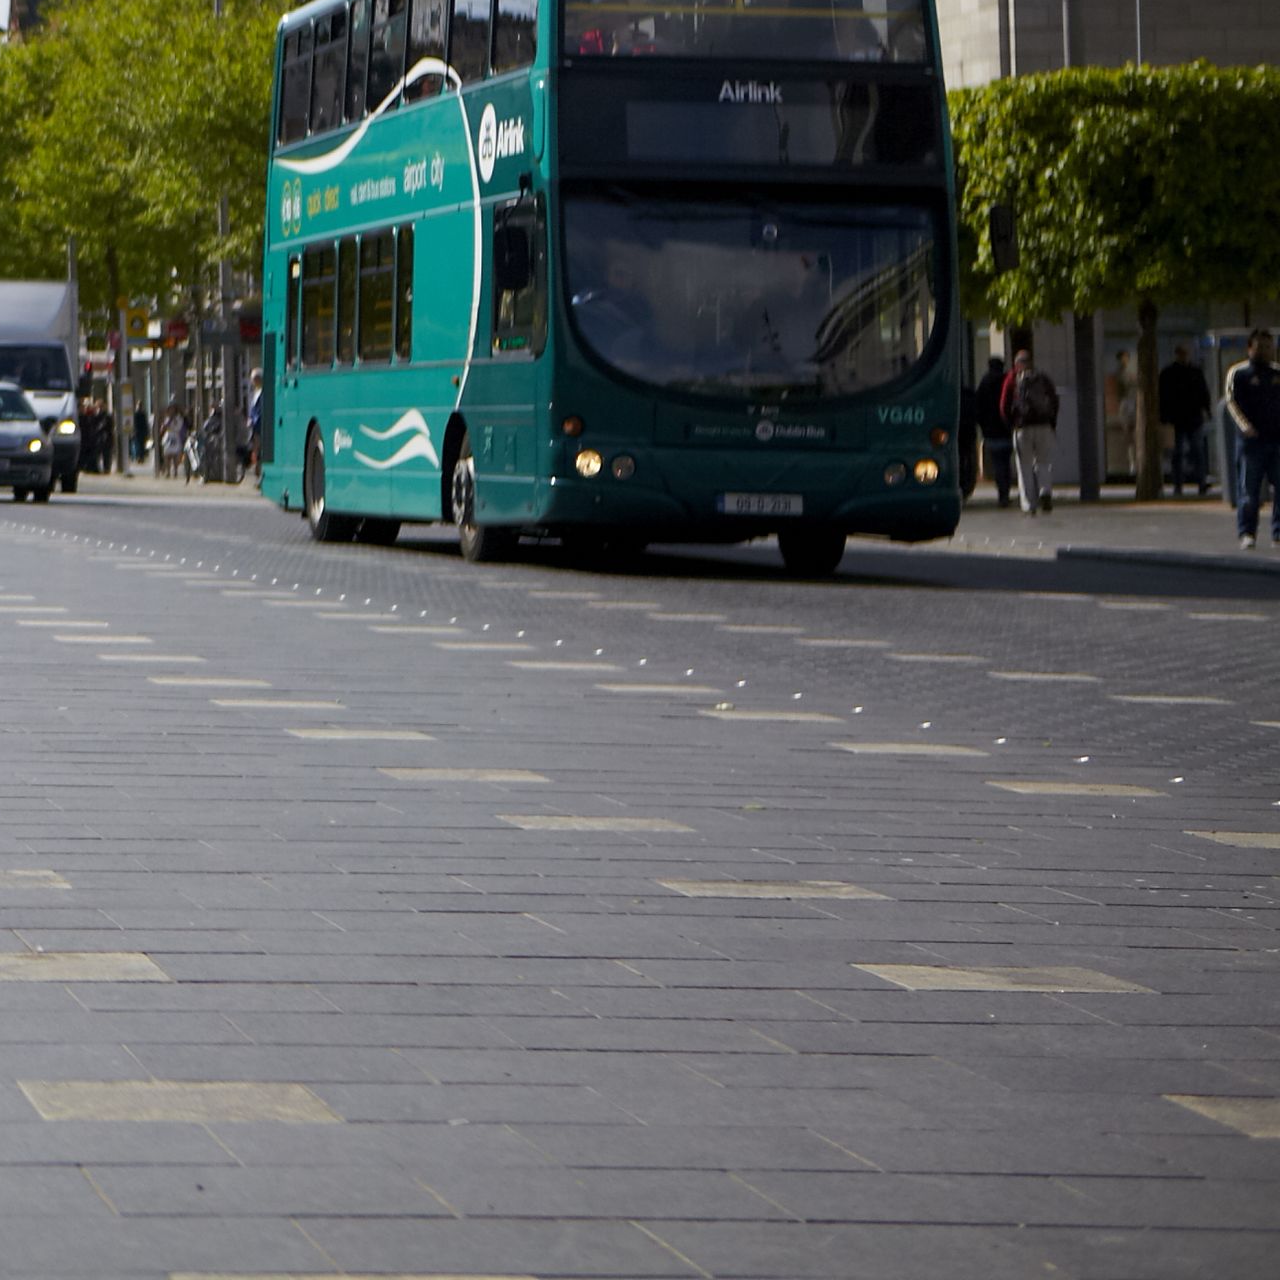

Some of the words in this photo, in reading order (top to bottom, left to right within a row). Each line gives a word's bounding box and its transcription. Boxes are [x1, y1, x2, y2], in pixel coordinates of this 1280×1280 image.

[719, 79, 783, 103] Airlink
[496, 115, 525, 160] Airlink
[403, 158, 427, 198] airport
[430, 151, 445, 193] city
[877, 405, 925, 425] VG40
